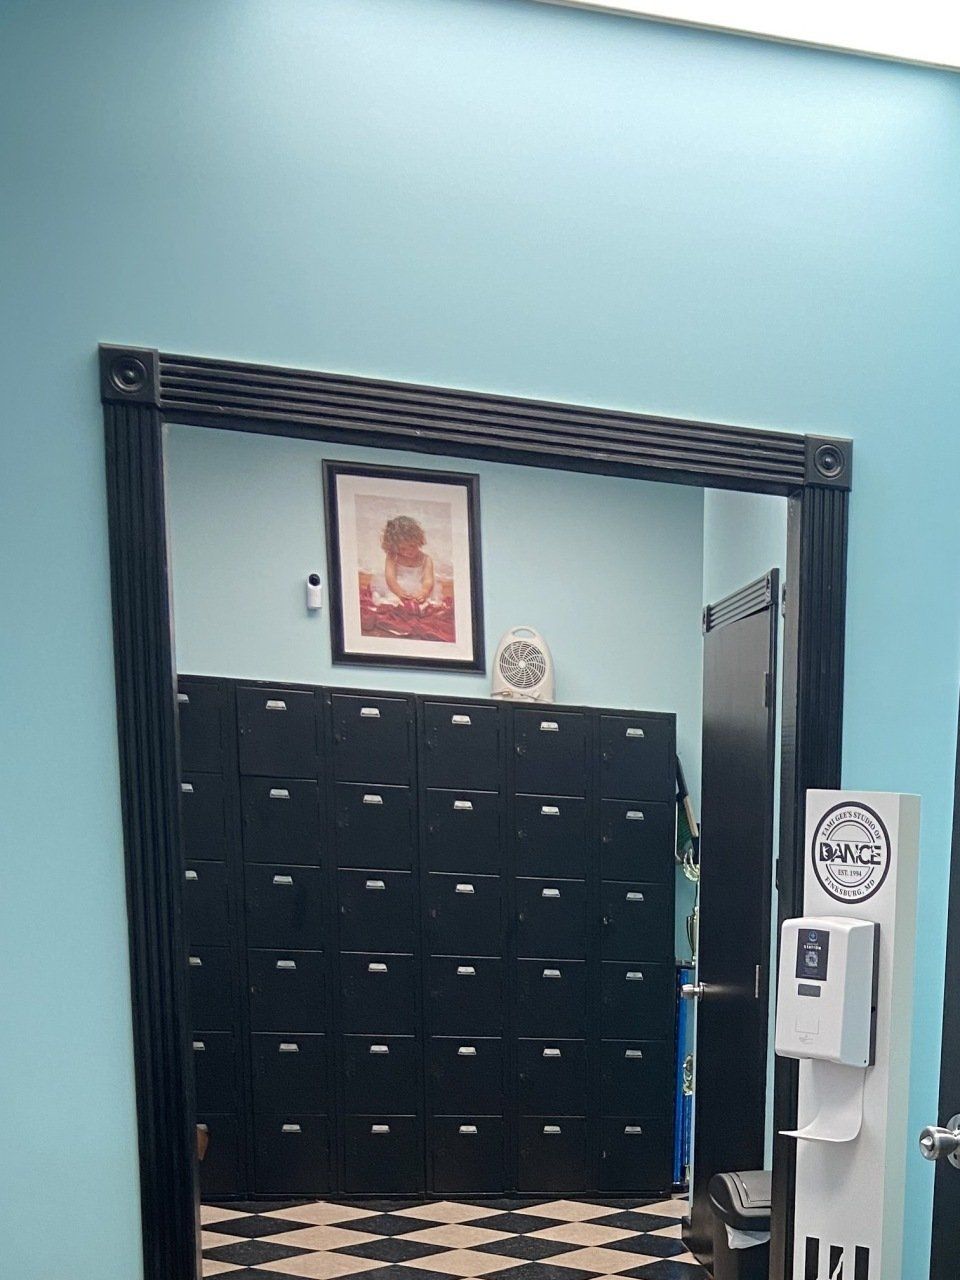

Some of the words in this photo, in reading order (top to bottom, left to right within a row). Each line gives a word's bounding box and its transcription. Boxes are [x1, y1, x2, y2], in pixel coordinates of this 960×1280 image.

[822, 819, 836, 837] TAMI
[835, 811, 853, 821] GEE'S
[853, 811, 876, 830] STUDIO
[875, 829, 882, 840] OF
[820, 842, 881, 865] DANCE
[824, 876, 865, 897] FINKSBURG,
[864, 879, 875, 891] MD
